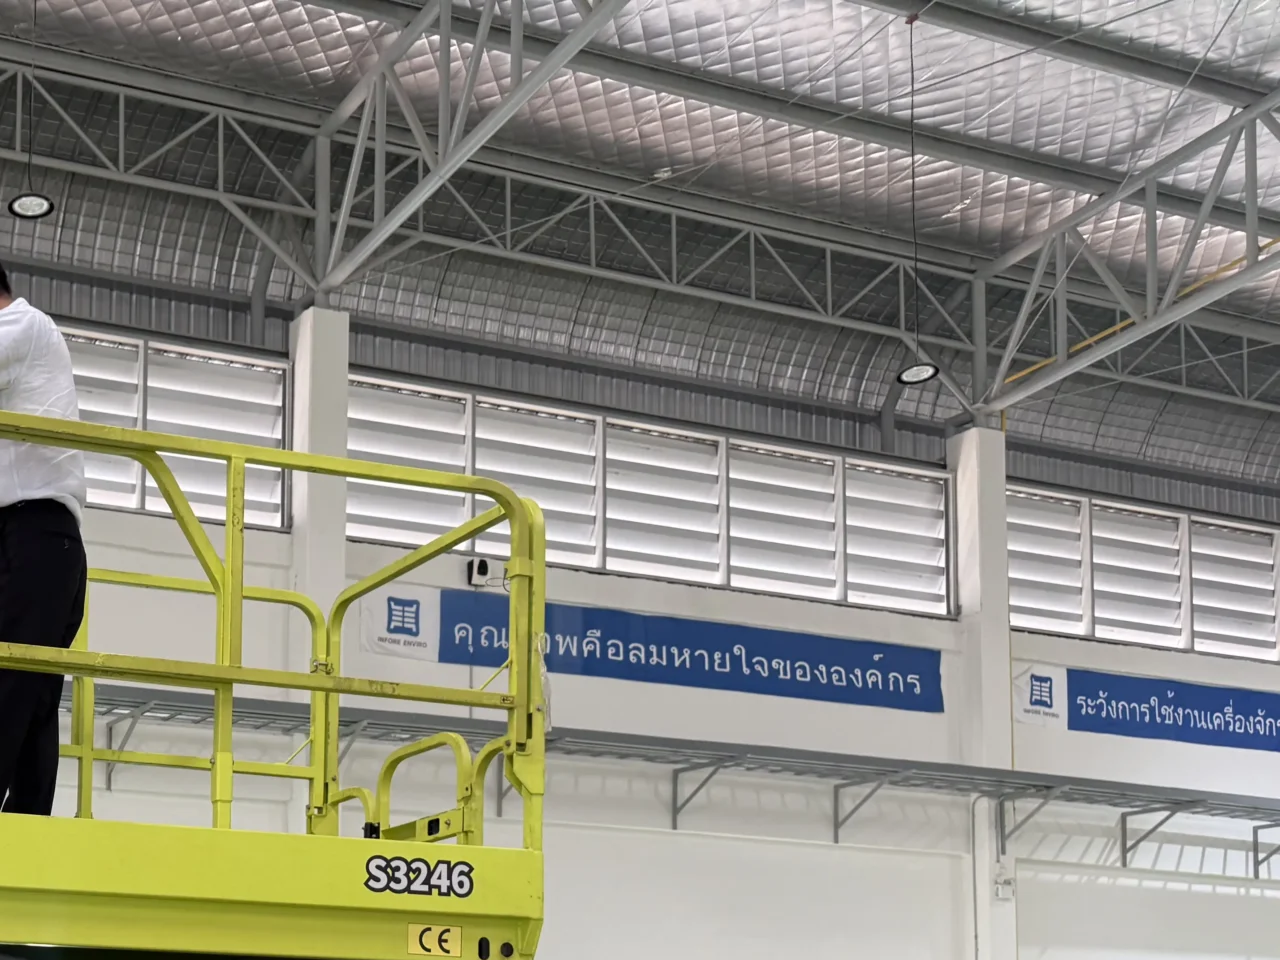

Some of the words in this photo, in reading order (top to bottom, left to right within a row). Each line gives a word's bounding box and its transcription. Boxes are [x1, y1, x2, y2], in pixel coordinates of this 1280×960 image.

[453, 622, 921, 695] คุณาพคือลมหายใจขององค์กร
[364, 855, 475, 898] S3246
[418, 926, 451, 954] CE
